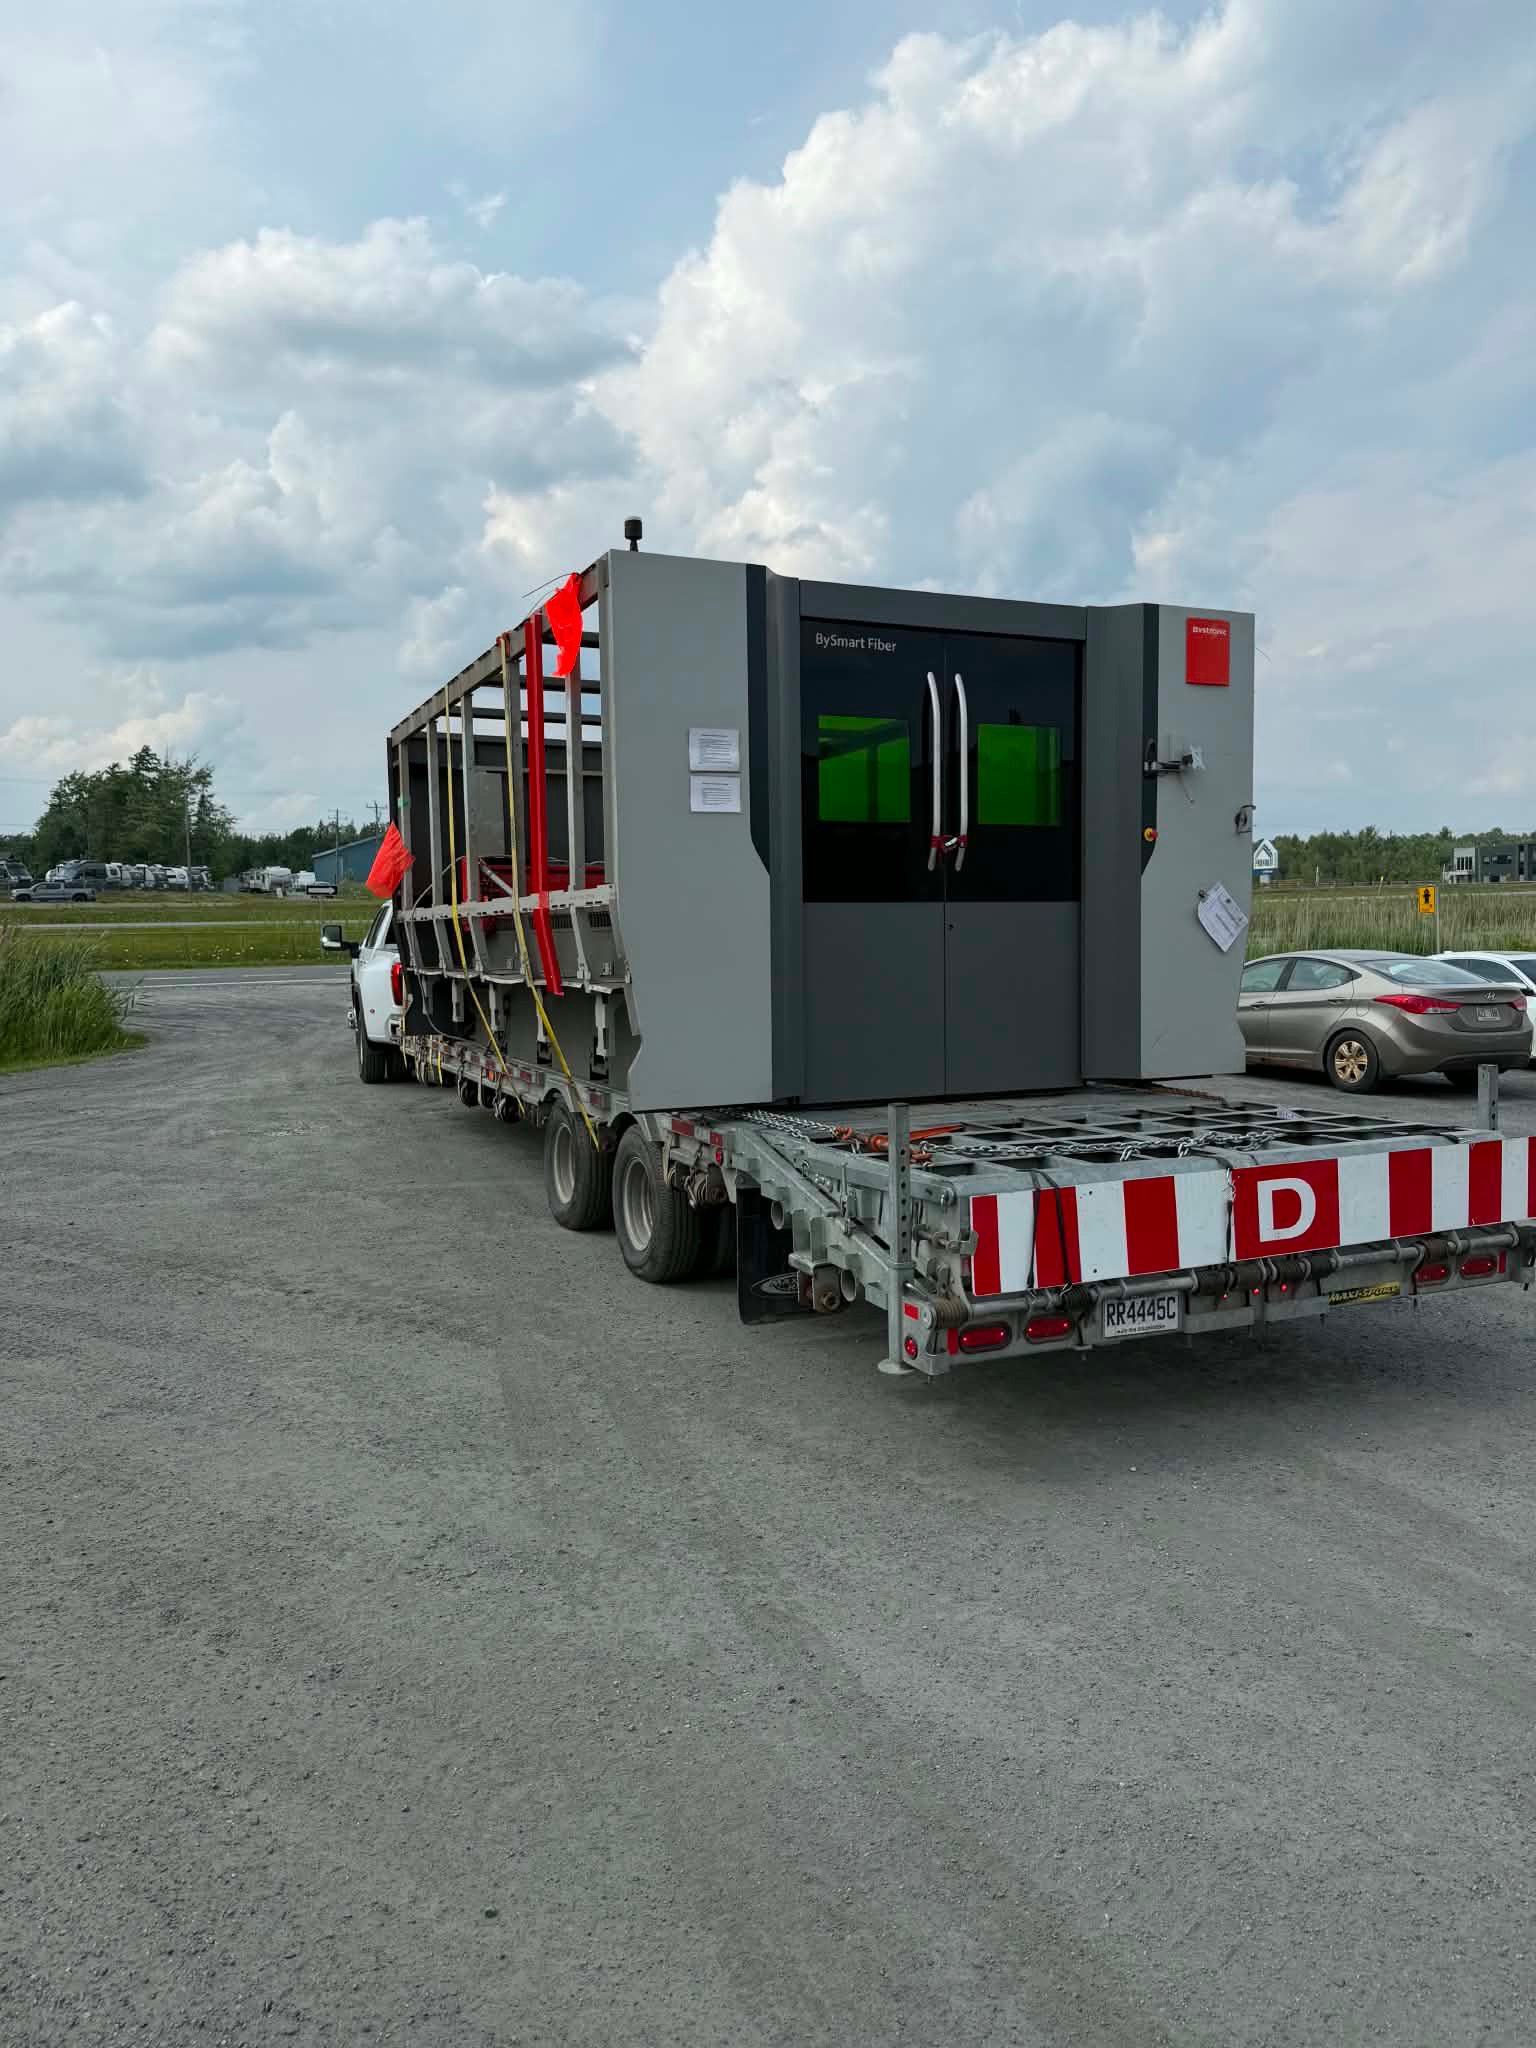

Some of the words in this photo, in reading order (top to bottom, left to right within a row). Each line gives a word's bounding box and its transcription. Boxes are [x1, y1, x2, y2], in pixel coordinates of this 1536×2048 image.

[815, 632, 865, 649] BySmart
[867, 637, 897, 652] Fiber
[1256, 1177, 1317, 1243] D
[1106, 1297, 1176, 1326] RR4445C
